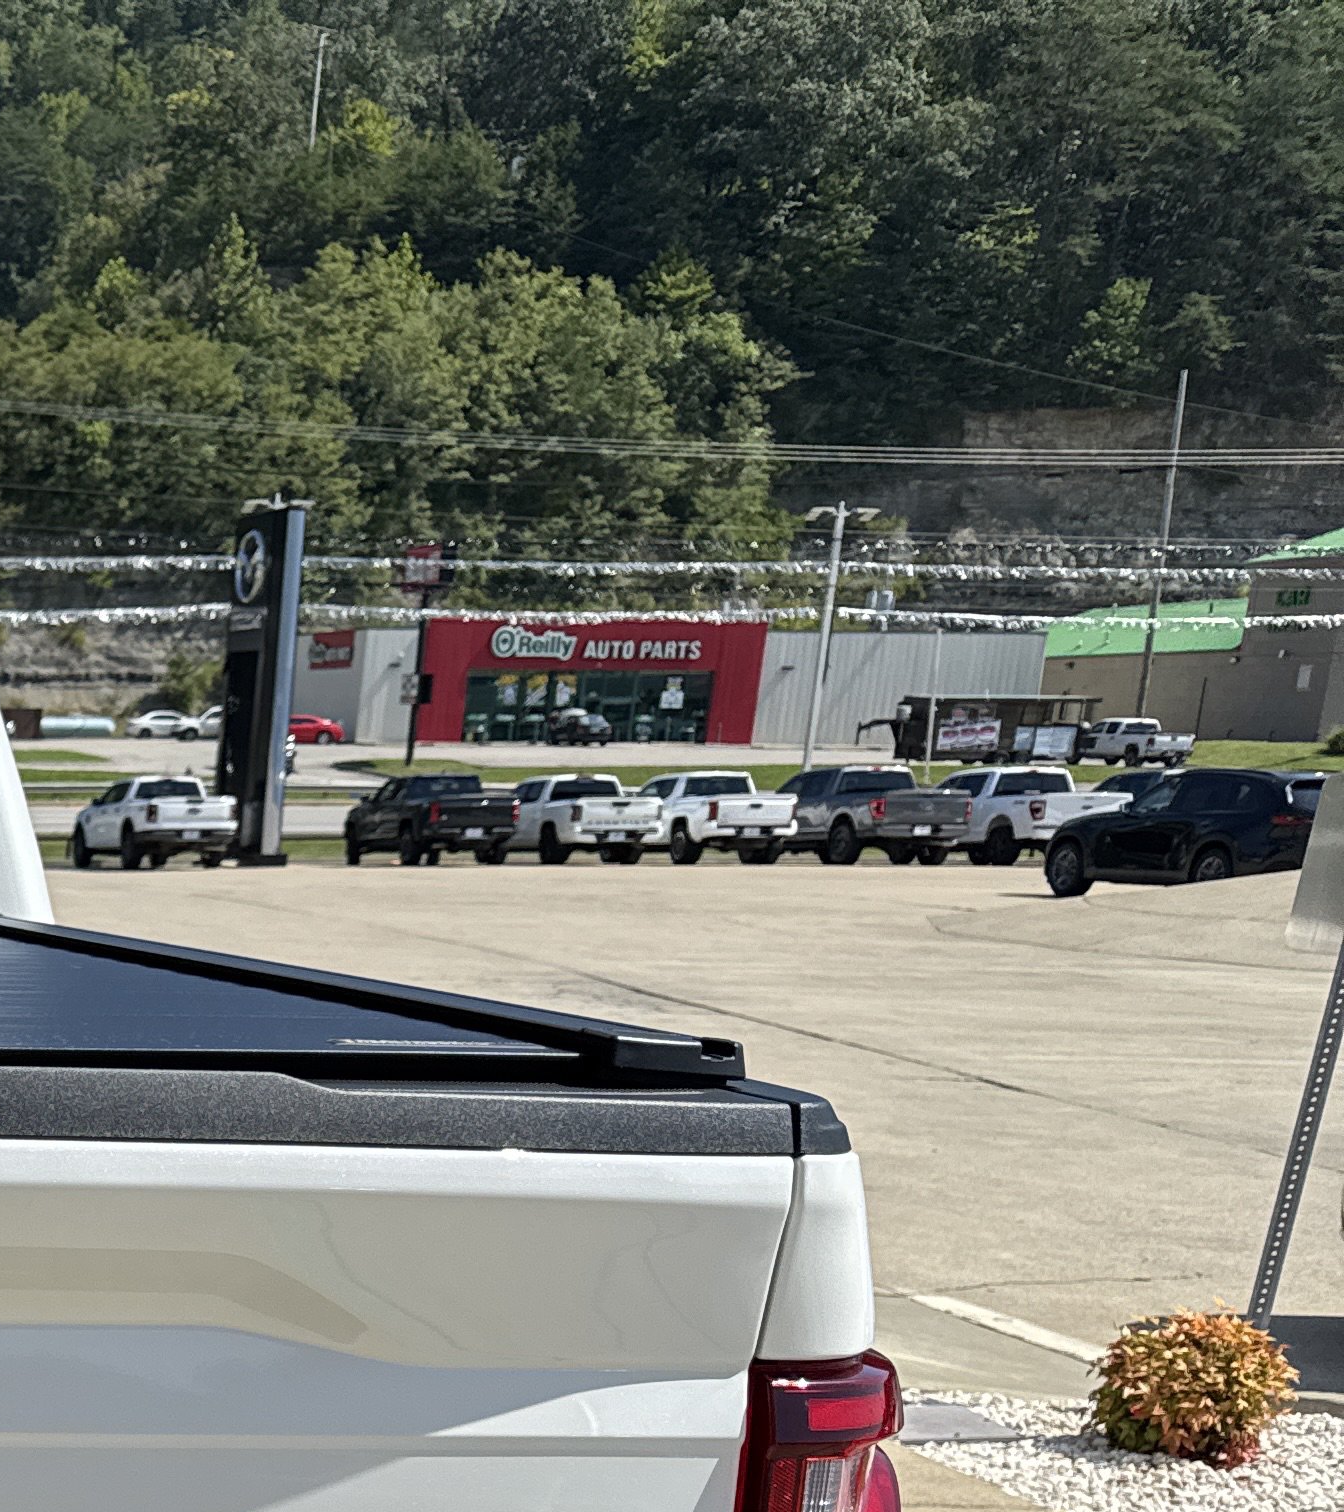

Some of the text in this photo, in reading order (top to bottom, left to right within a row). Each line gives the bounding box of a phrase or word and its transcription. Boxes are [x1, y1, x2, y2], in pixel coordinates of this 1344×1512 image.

[492, 626, 702, 661] O'Reilly AUTO PARTS
